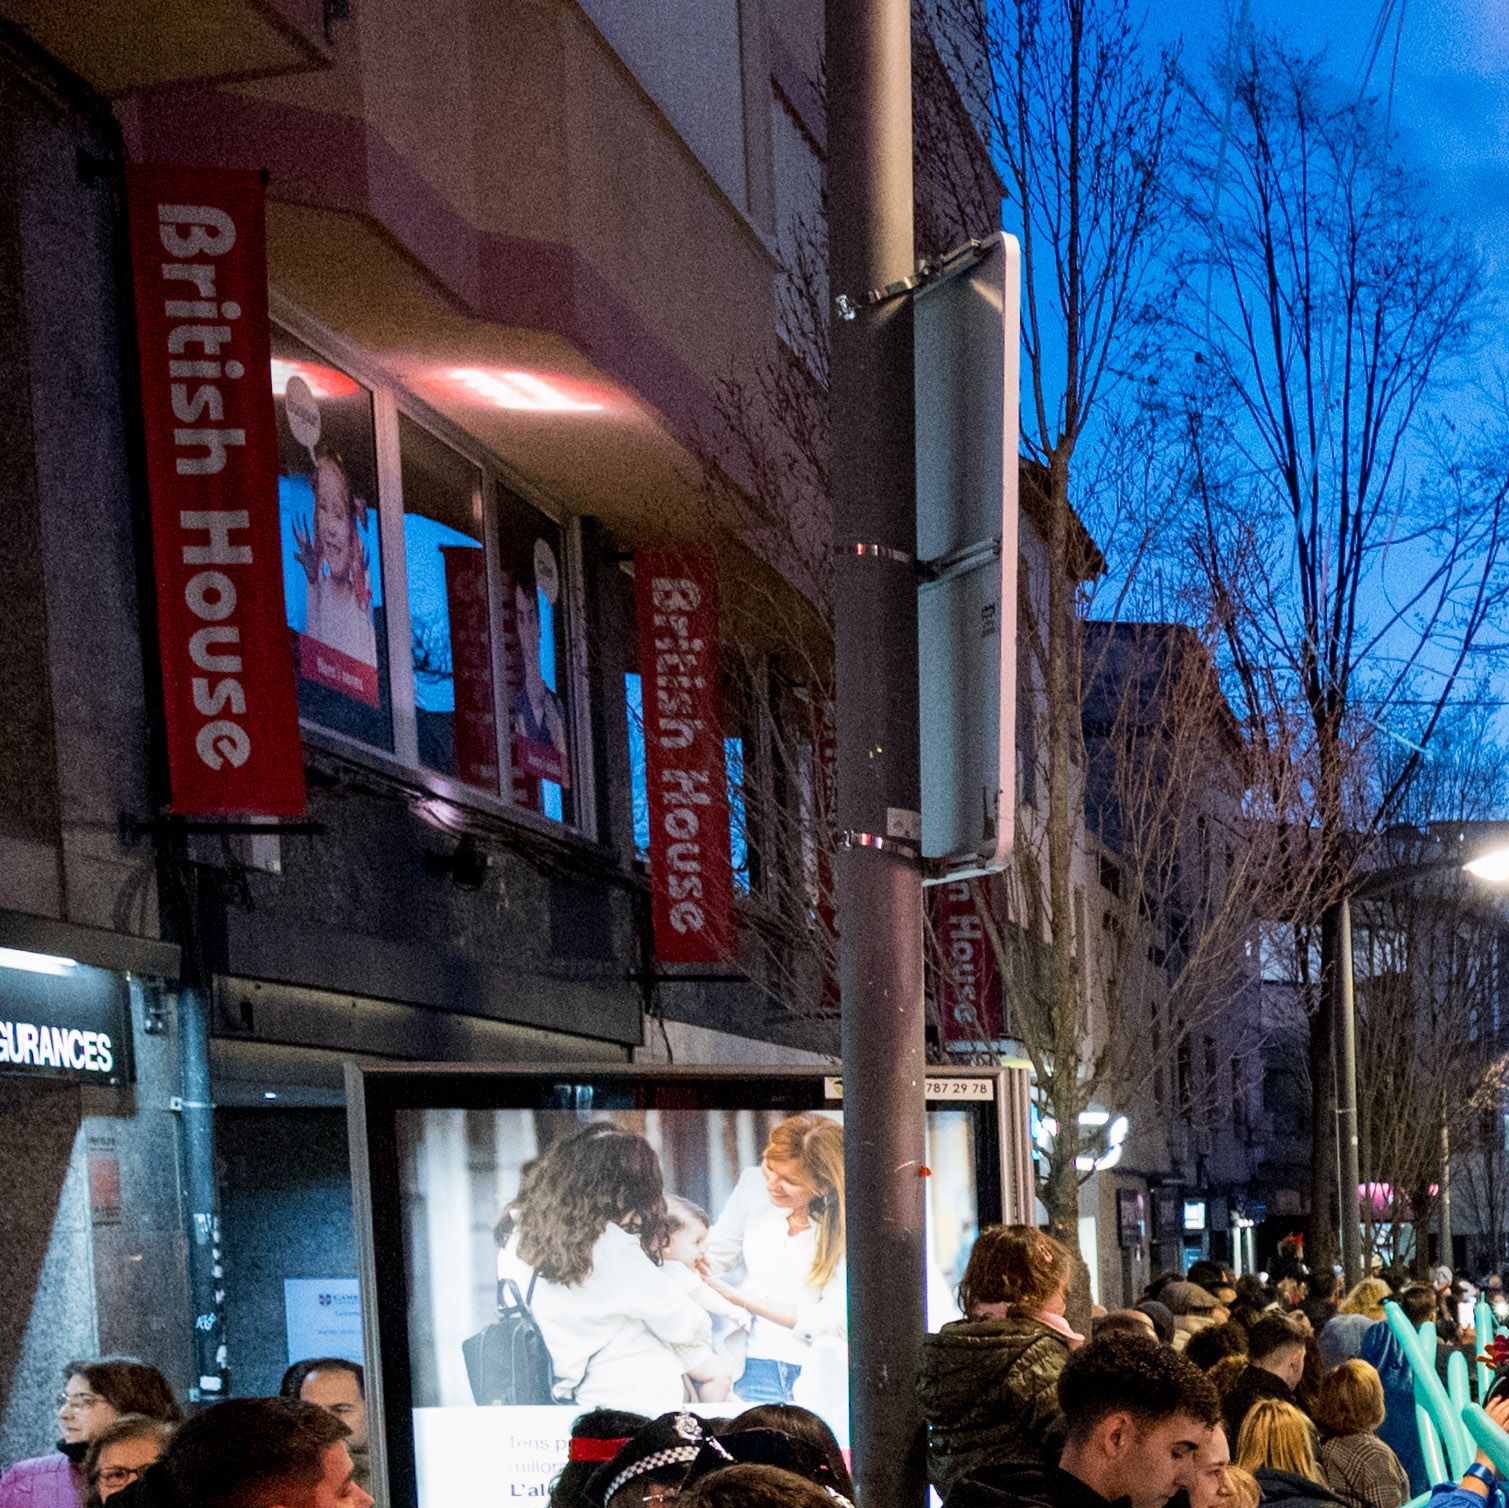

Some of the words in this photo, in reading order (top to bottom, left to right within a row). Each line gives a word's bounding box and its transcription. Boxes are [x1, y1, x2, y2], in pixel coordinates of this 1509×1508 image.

[157, 203, 247, 475] British
[179, 510, 253, 772] House
[661, 768, 711, 935] House
[951, 914, 982, 1024] House
[926, 1083, 948, 1093] 787
[953, 1083, 968, 1093] 29
[972, 1083, 987, 1094] 78
